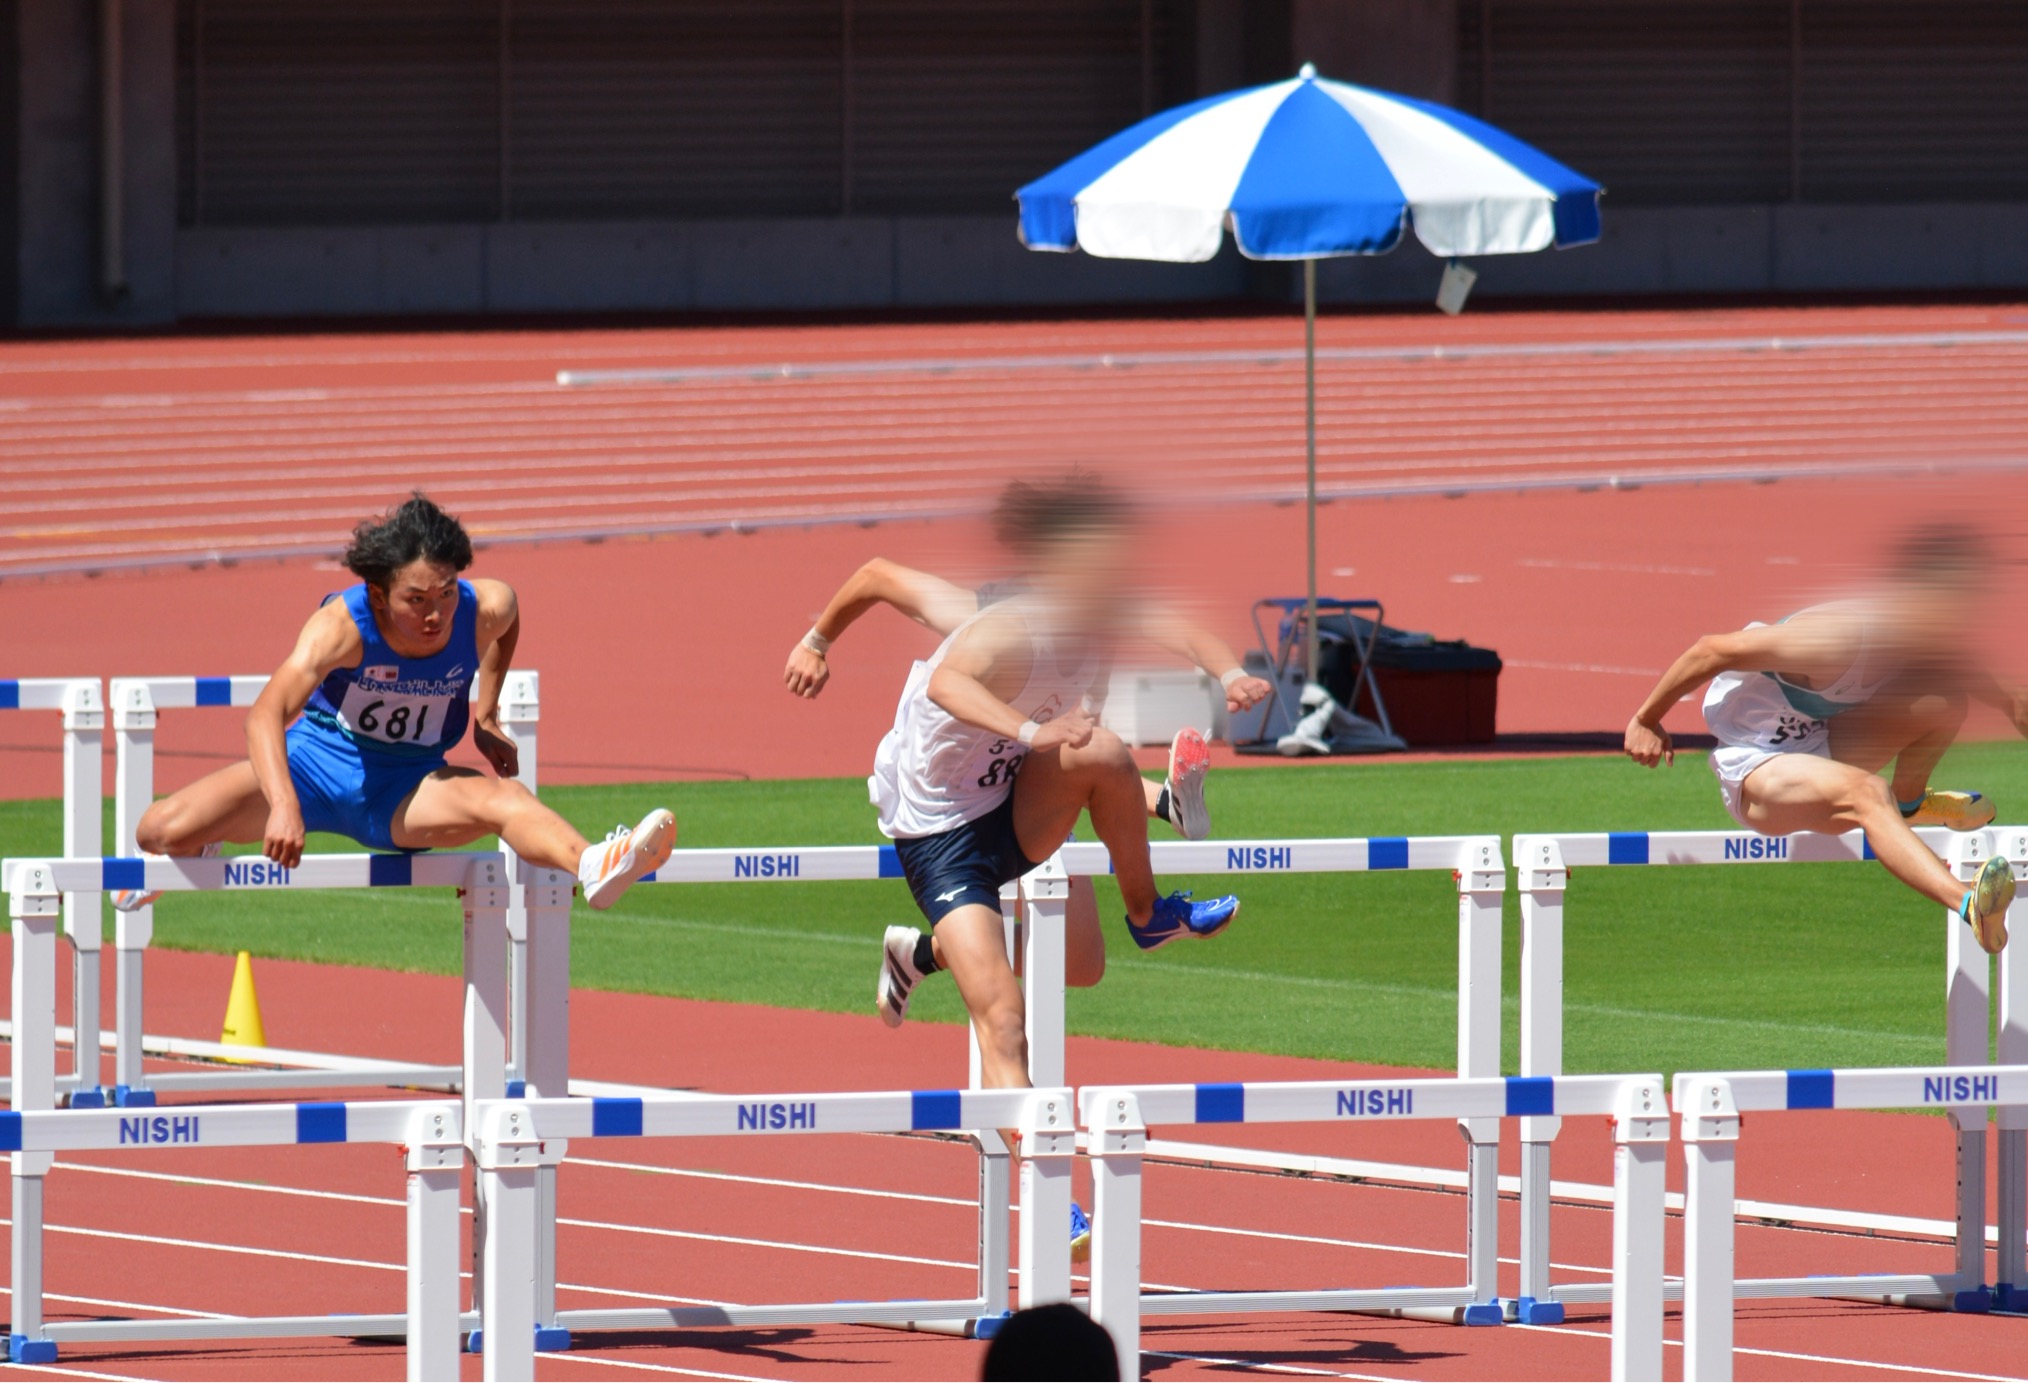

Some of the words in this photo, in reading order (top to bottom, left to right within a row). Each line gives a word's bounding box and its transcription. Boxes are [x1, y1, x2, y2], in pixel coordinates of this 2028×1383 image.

[358, 700, 429, 741] 681
[1227, 847, 1291, 870] NISHI
[1724, 837, 1788, 859] NISHI
[225, 863, 290, 886] NISHI
[734, 855, 800, 878] NISHI
[1924, 1076, 1998, 1102] NISHI
[1337, 1089, 1413, 1116] NISHI
[737, 1103, 816, 1130] NISHI
[119, 1116, 200, 1144] NISHI
